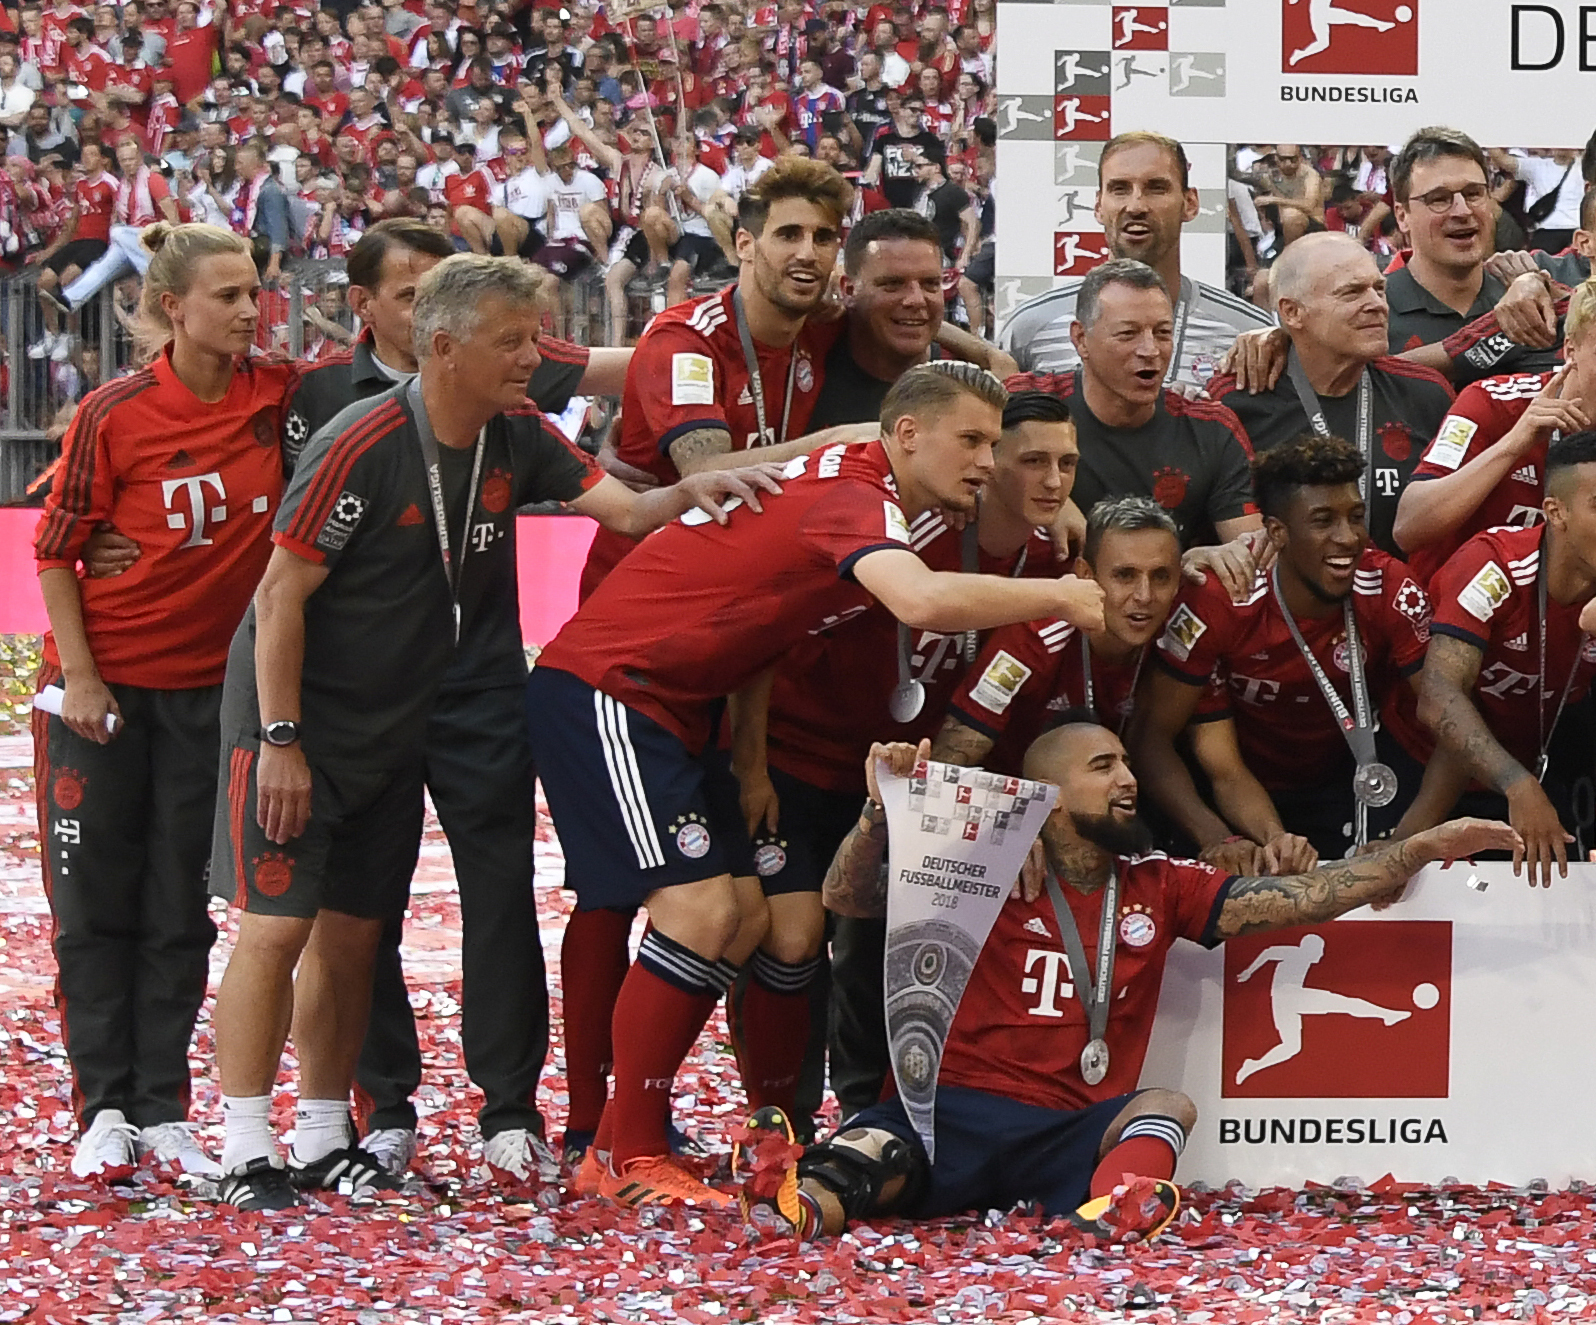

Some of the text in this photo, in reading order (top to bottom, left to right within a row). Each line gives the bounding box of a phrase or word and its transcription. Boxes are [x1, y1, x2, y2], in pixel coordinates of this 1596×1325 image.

[1281, 85, 1419, 104] BUNDESLIGA
[429, 463, 450, 551] BUNDESLIGA
[1303, 644, 1349, 721] BUNDESLIGA
[922, 855, 987, 879] DEUTSCHER
[899, 869, 1002, 899] FUSSBALLMEISTER
[930, 892, 959, 911] 2018
[1218, 1118, 1449, 1145] BUNDESLIGA
